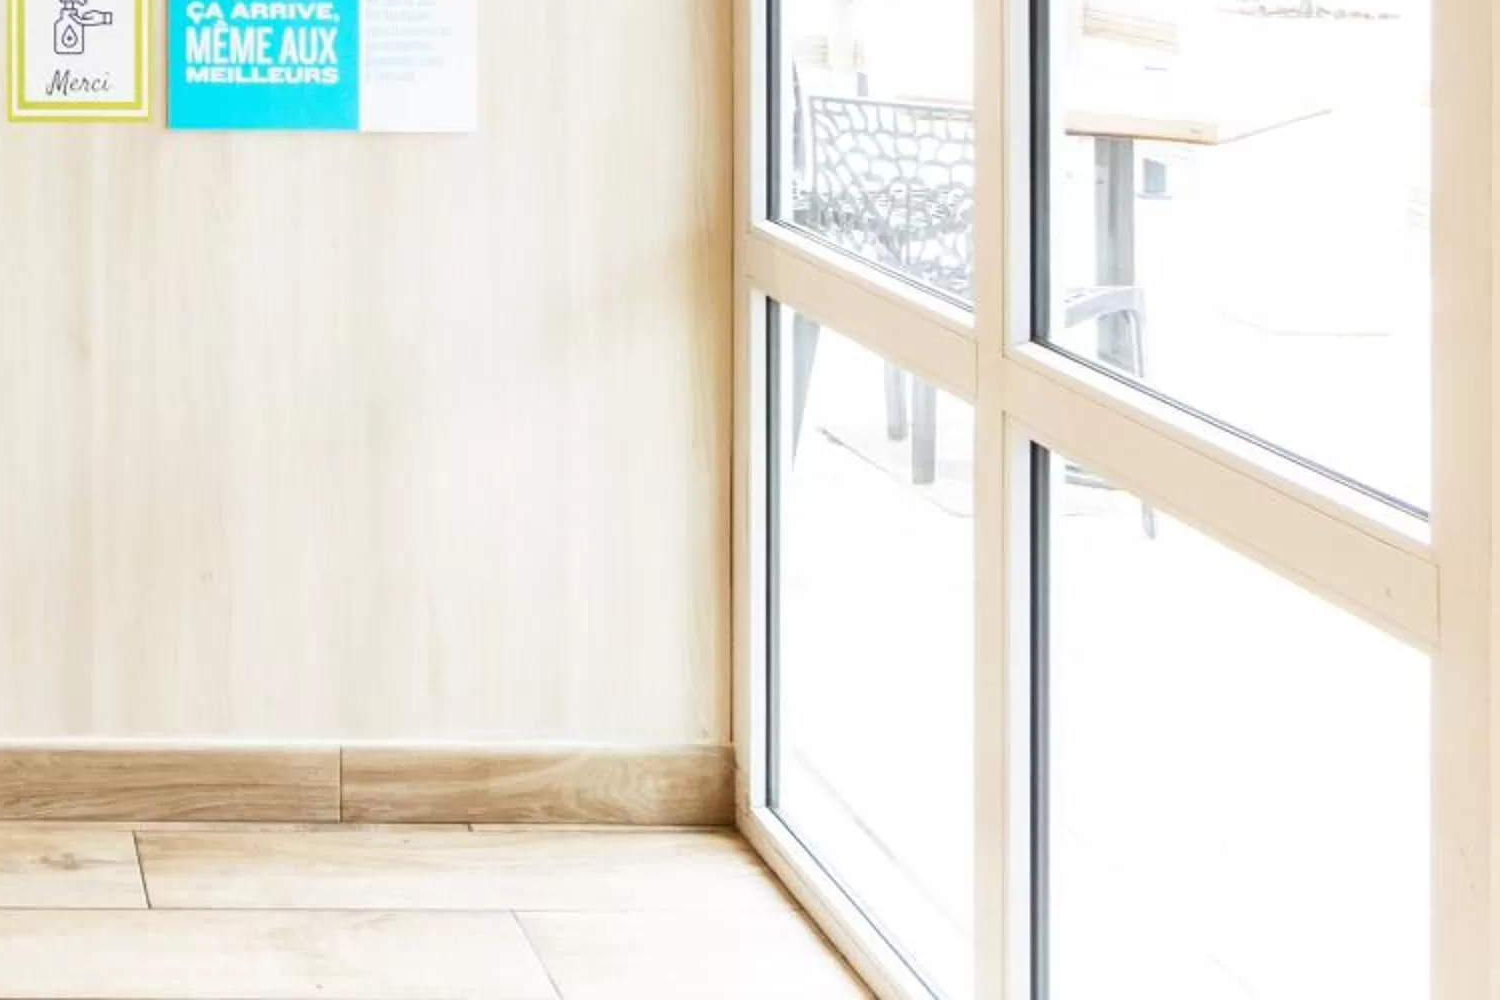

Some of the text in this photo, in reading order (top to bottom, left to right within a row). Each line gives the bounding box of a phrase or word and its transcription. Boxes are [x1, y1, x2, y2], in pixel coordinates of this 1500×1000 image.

[186, 1, 341, 24] ÇA ARRIVE,
[185, 20, 274, 65] MÊME
[279, 26, 339, 65] AUX
[45, 68, 112, 97] Merci
[185, 66, 340, 84] MEILLEURS
